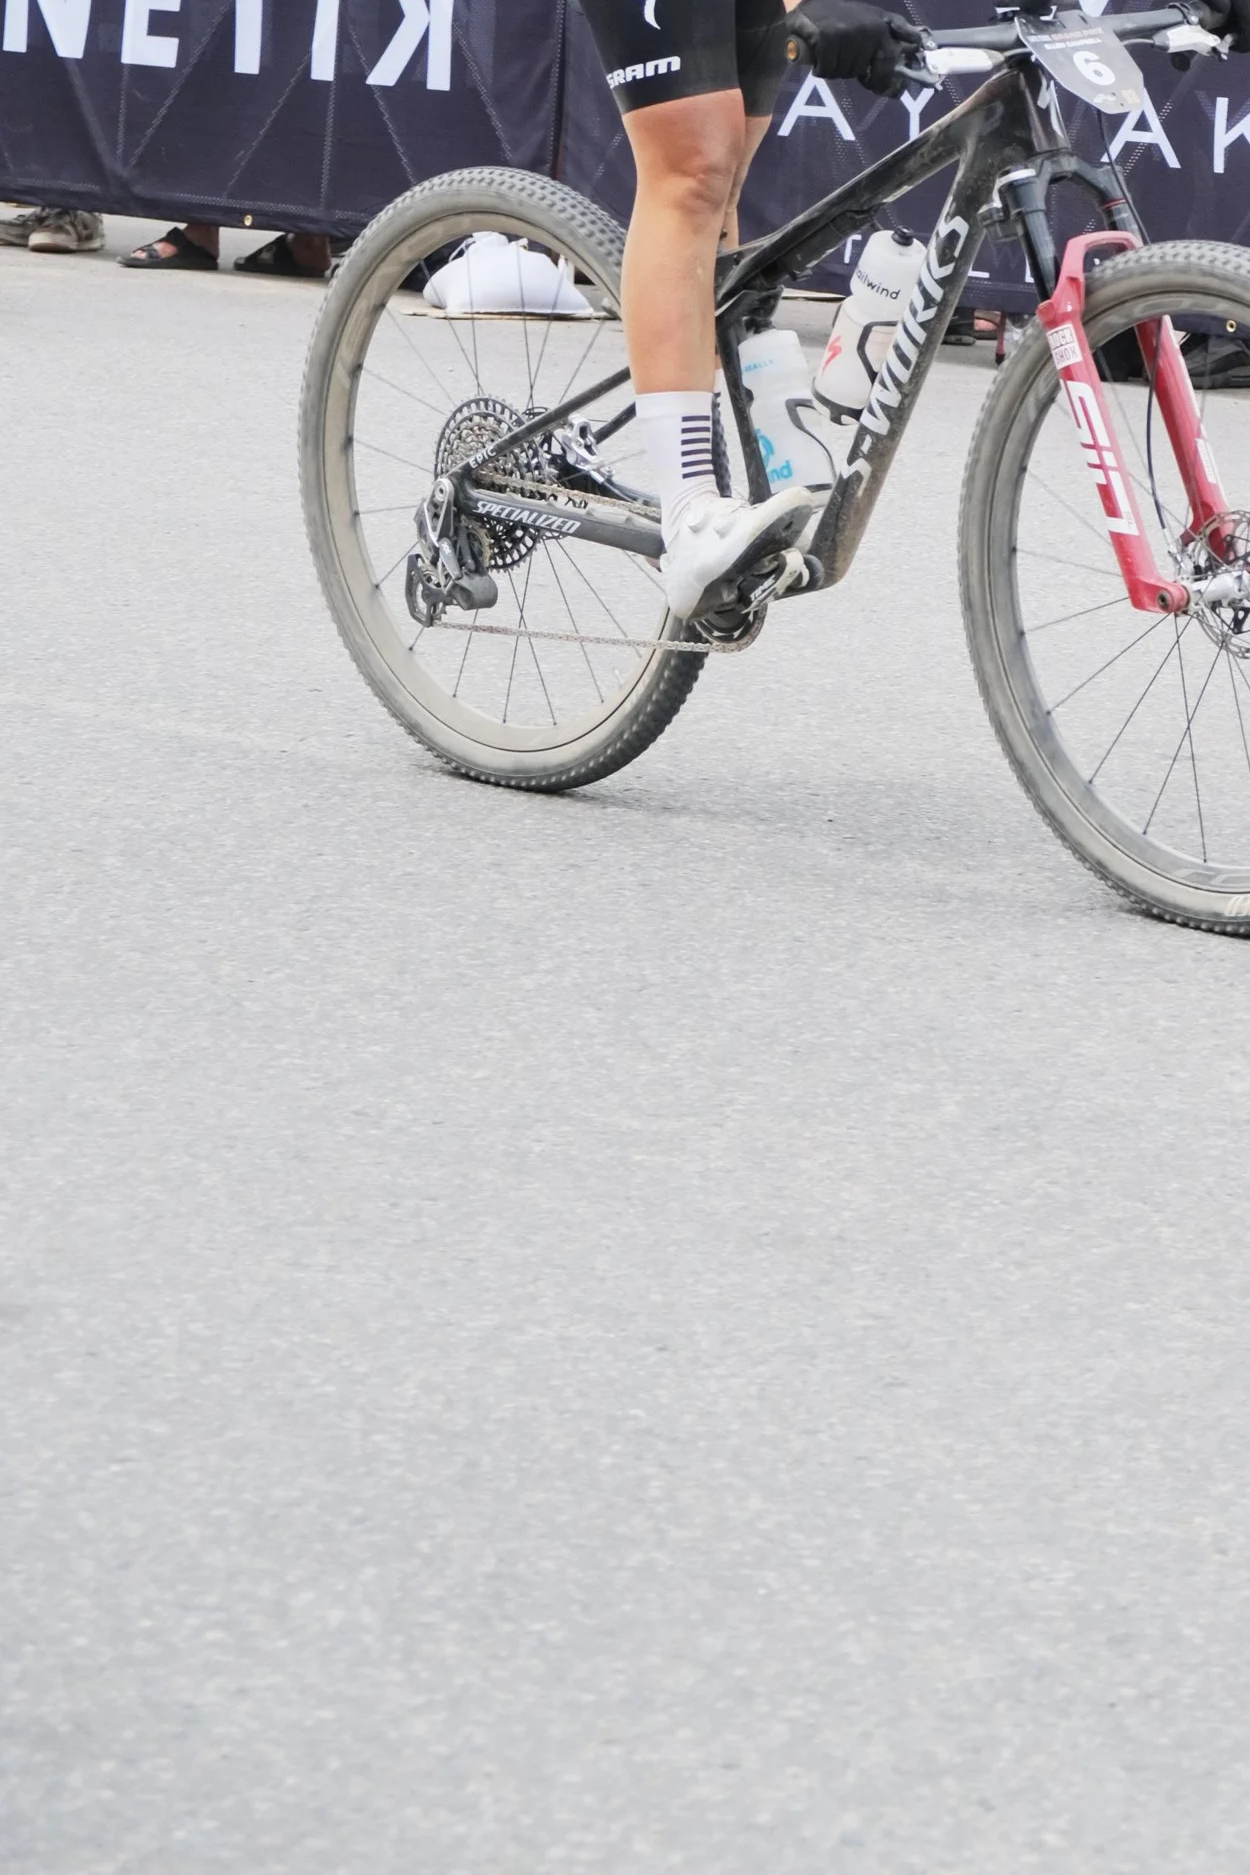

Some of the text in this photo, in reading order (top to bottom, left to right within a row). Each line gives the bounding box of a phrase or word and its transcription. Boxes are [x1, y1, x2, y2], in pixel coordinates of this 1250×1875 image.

[1072, 50, 1116, 86] 6
[856, 269, 901, 300] ailwind
[841, 215, 969, 497] S-WORKS
[469, 446, 497, 469] EPIC
[473, 501, 582, 534] SPECIALIZED
